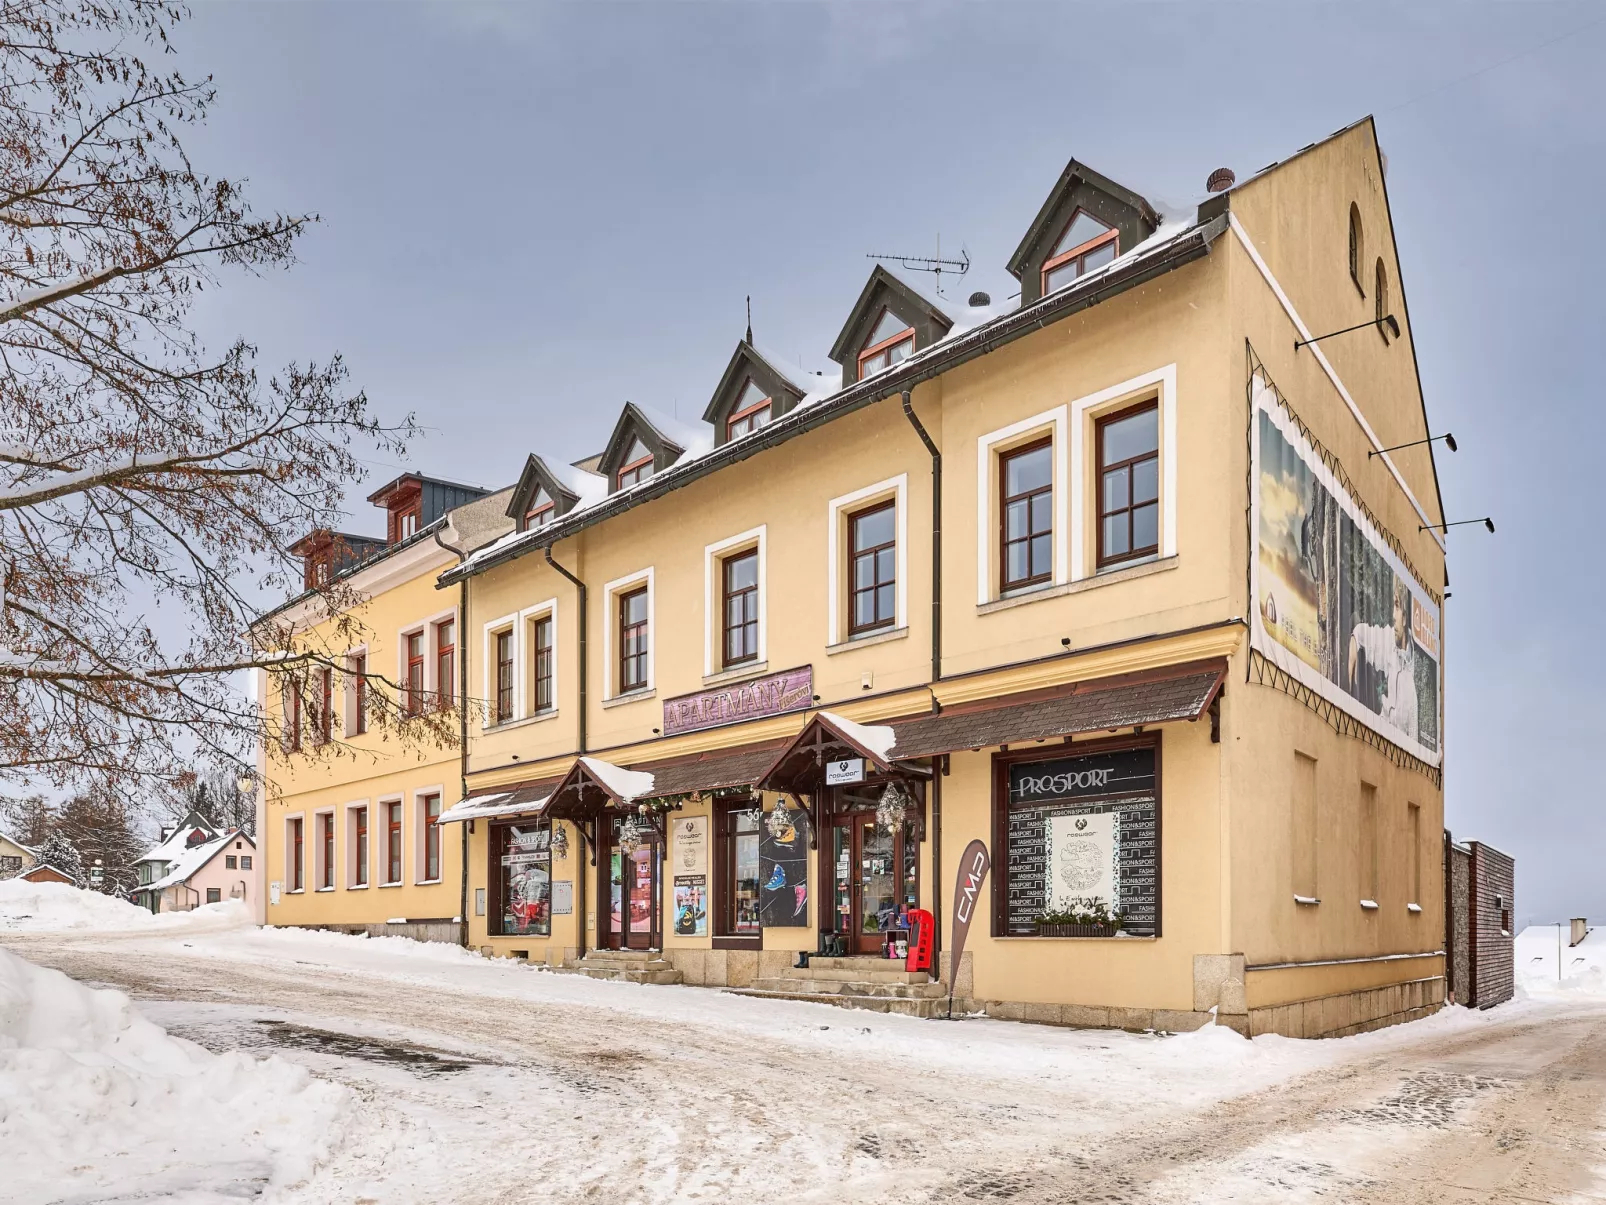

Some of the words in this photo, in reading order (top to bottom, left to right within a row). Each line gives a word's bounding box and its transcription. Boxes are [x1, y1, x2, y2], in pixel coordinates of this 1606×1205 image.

[666, 679, 788, 728] APARTMÁNY
[1019, 769, 1115, 797] PROSPORT
[957, 851, 985, 923] CMP
